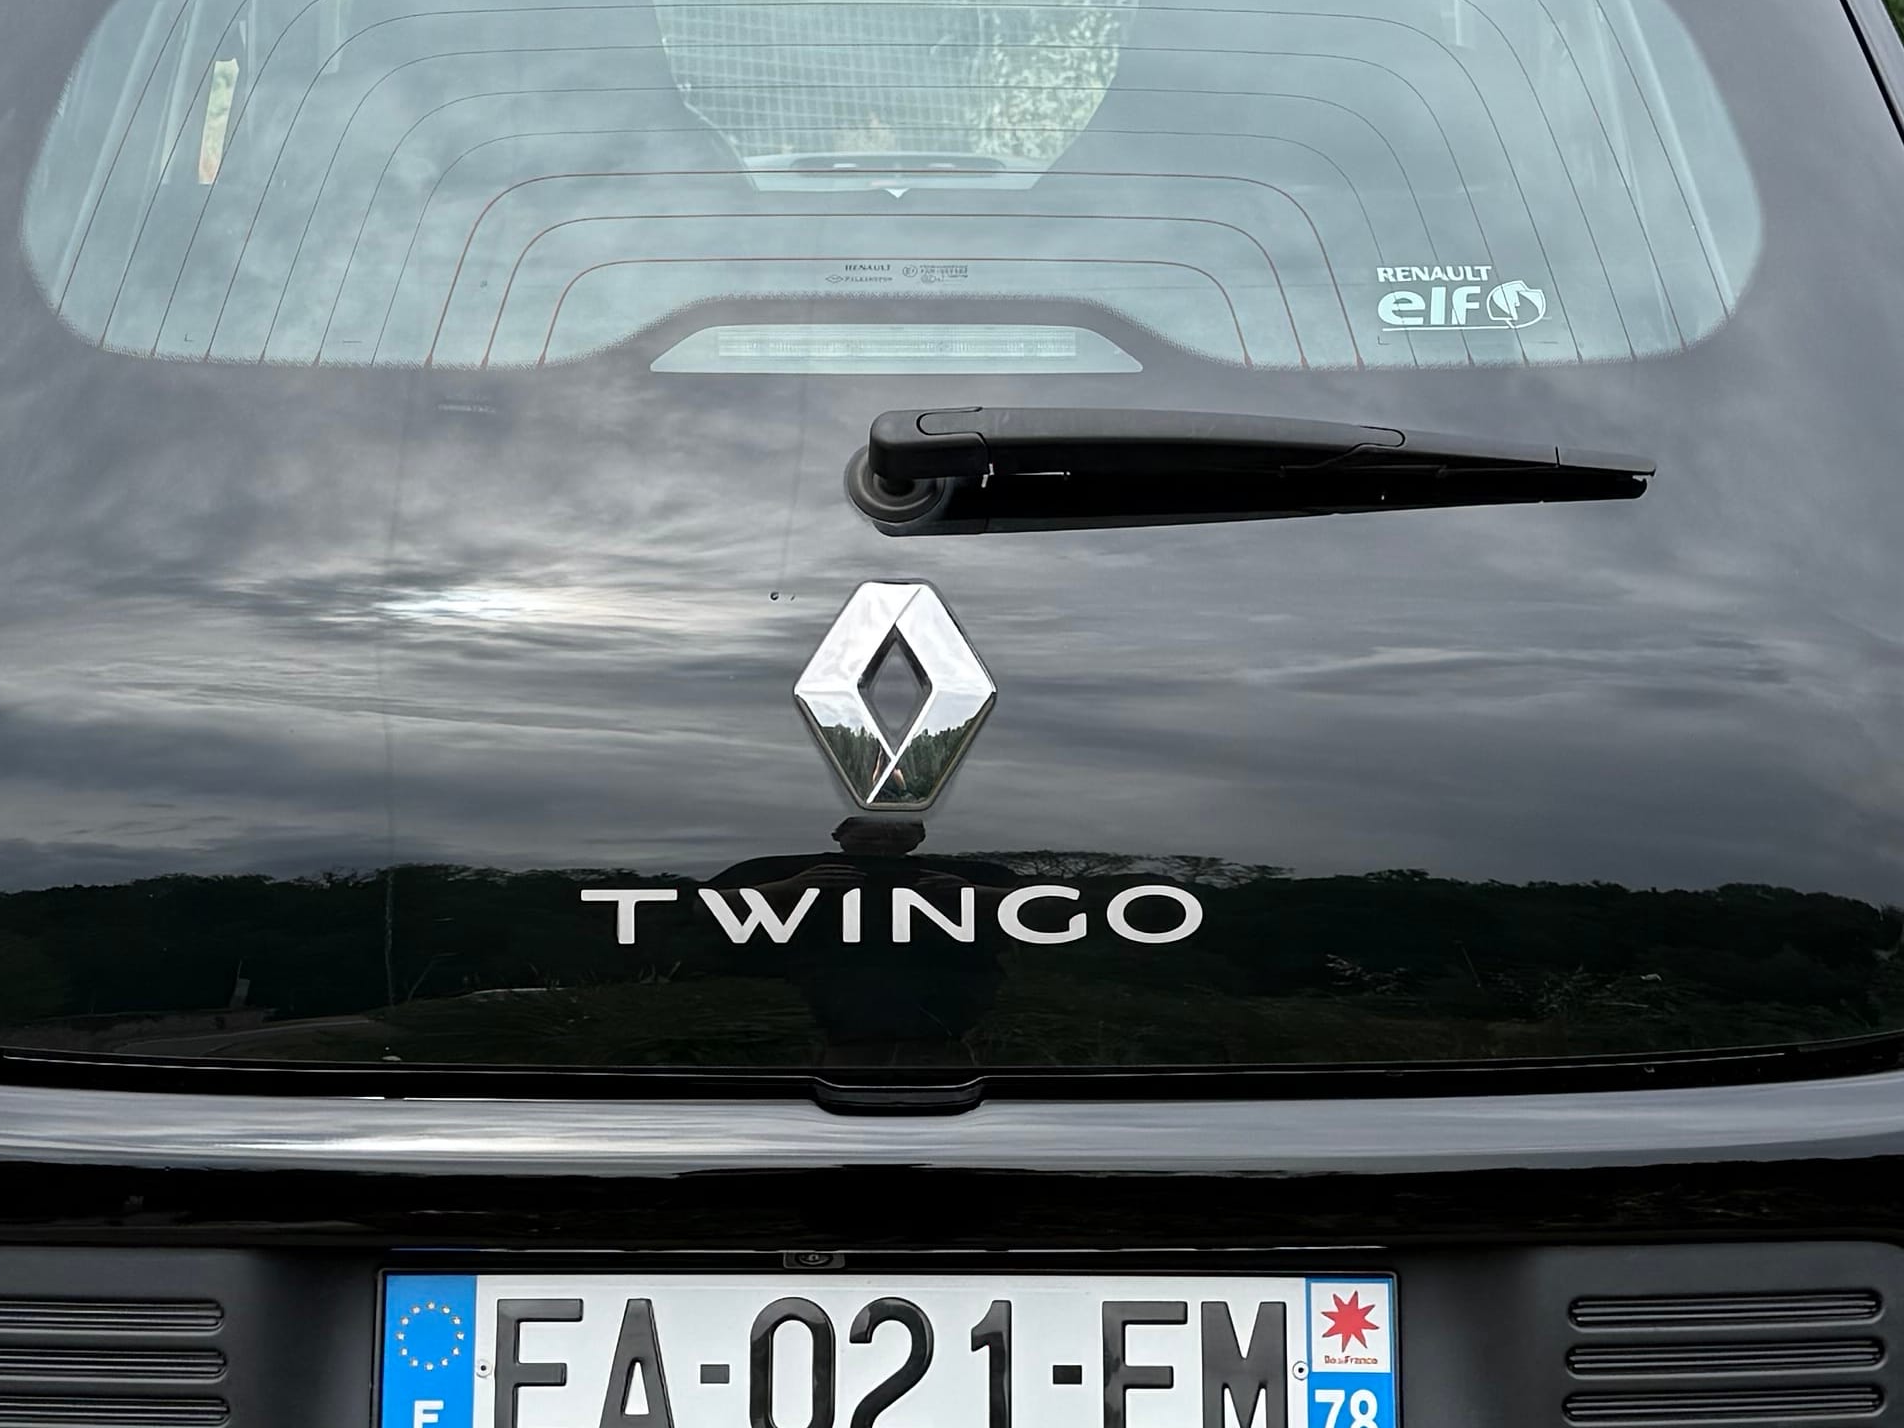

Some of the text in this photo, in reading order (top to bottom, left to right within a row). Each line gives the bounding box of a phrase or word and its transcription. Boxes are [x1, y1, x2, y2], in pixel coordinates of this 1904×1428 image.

[1376, 265, 1492, 282] RENAULT
[1377, 285, 1481, 326] elf
[580, 884, 1204, 945] TWINGO
